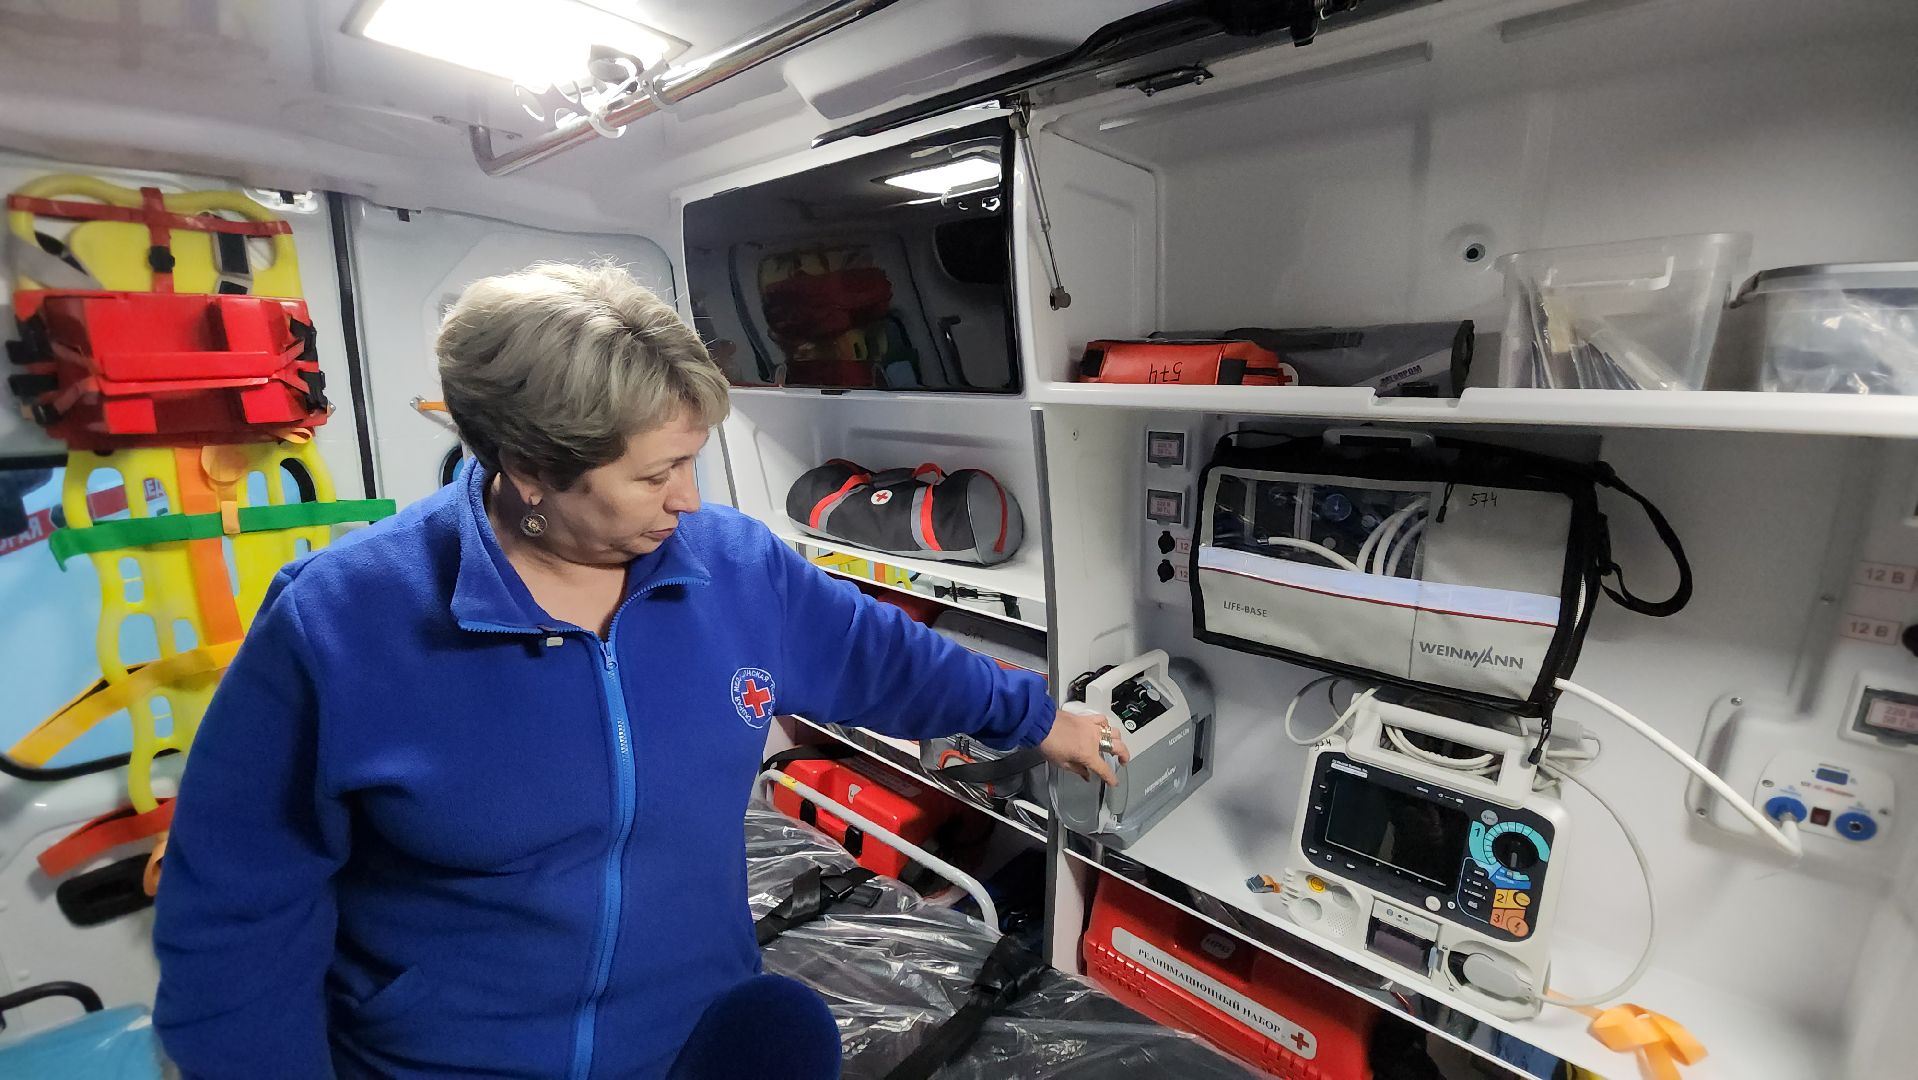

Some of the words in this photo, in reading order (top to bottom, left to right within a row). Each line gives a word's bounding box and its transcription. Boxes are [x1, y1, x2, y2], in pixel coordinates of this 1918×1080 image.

[1469, 491, 1498, 508] 574
[1181, 542, 1189, 550] 12
[1180, 570, 1188, 578] 12
[1866, 567, 1886, 582] 12
[1223, 600, 1268, 618] LIFE-BASE
[1850, 622, 1870, 634] 12
[1496, 893, 1504, 904] 2
[1493, 913, 1500, 924] 3
[1138, 948, 1241, 1012] РЕАНИМАЦИОННЫЙ
[1243, 1007, 1281, 1033] НАБОР
